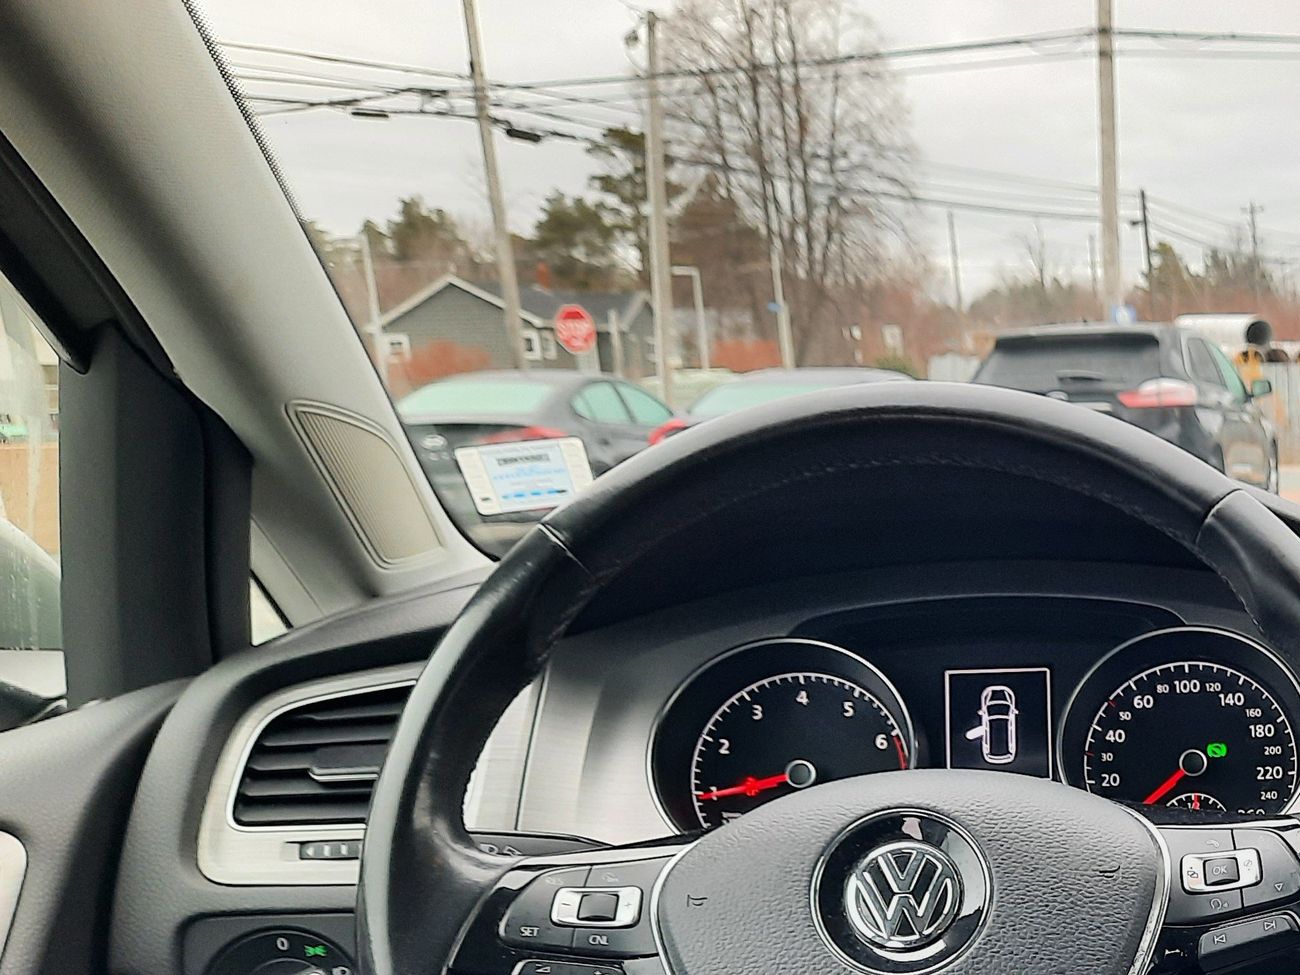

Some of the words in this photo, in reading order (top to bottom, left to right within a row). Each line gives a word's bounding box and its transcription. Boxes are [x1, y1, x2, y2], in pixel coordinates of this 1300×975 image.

[1156, 684, 1170, 694] 80
[1174, 679, 1201, 694] 100
[1205, 682, 1222, 692] 120
[795, 690, 810, 706] 4
[1133, 695, 1154, 709] 60
[1219, 693, 1245, 707] 140
[752, 704, 764, 720] 3
[843, 701, 855, 718] 5
[1118, 711, 1132, 722] 50
[1245, 708, 1262, 718] 160
[1105, 729, 1126, 743] 40
[1249, 724, 1275, 738] 180
[718, 738, 730, 755] 2
[874, 734, 888, 750] 6
[1101, 752, 1114, 763] 30
[1263, 745, 1282, 756] 200
[1101, 773, 1120, 787] 20
[1256, 766, 1283, 781] 220
[1260, 790, 1278, 800] 240
[1212, 864, 1228, 875] OK
[520, 926, 540, 938] SET
[588, 935, 609, 946] CNL
